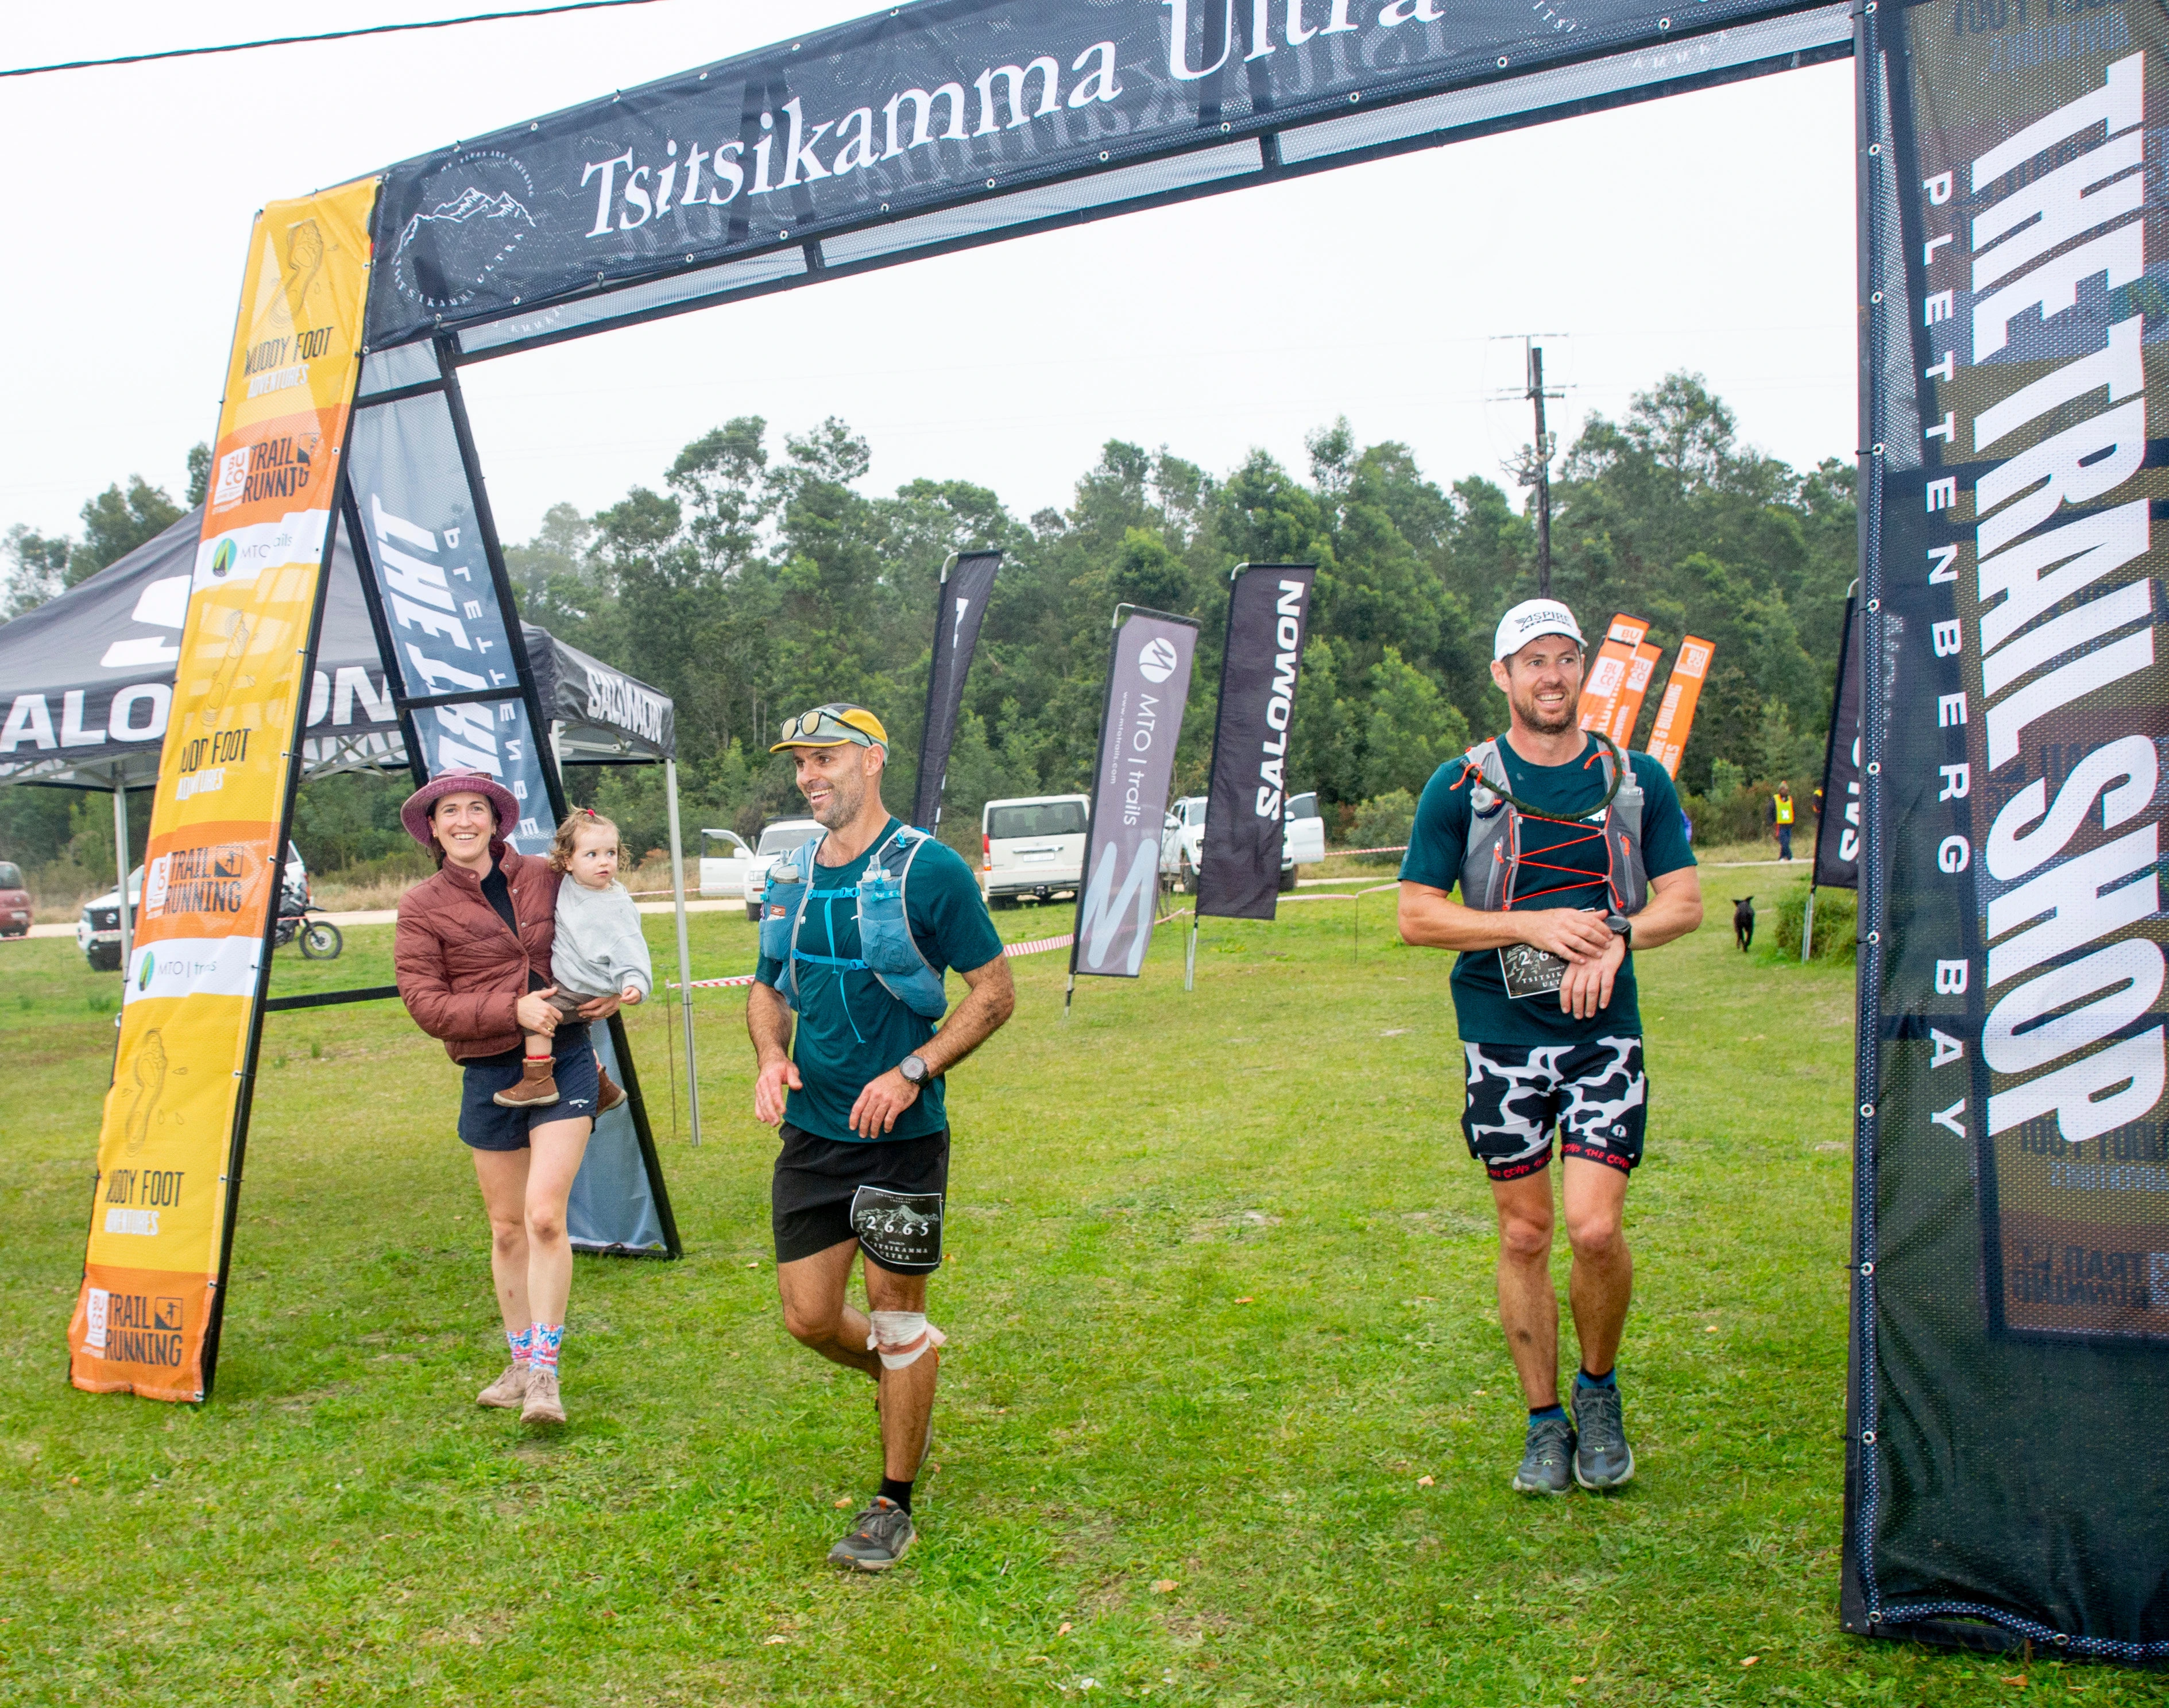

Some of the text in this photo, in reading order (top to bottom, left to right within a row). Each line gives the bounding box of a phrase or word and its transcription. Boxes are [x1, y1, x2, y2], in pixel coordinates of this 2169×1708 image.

[581, 41, 1123, 239] Tsitsikamma
[1972, 49, 2144, 366] THE
[477, 234, 523, 283] ULTRA
[293, 326, 334, 362] FOOT
[250, 437, 293, 472] TRAIL
[1974, 312, 2154, 772] TRAIL
[1522, 611, 1571, 628] ASPIRE
[1621, 629, 1640, 639] BU
[1923, 169, 1970, 1138] PLETTENBERG BAY
[587, 667, 662, 744] SALOMON
[1255, 579, 1305, 821] SALOMON
[1656, 683, 1683, 730] BUILDING
[1109, 691, 1128, 785] www.mtotrails.com
[1133, 693, 1159, 752] MTO
[211, 728, 252, 764] FOOT
[1123, 770, 1145, 826] trails
[170, 847, 211, 882] TRAIL
[163, 880, 242, 915] RUNNING
[1982, 734, 2165, 1142] SHOP
[1522, 971, 1562, 984] TSITSIK
[1542, 979, 1560, 987] ULT
[141, 1170, 185, 1207] FOOT
[867, 1215, 929, 1236] 2665
[109, 1292, 152, 1330] TRAIL
[105, 1328, 183, 1367] RUNNING
